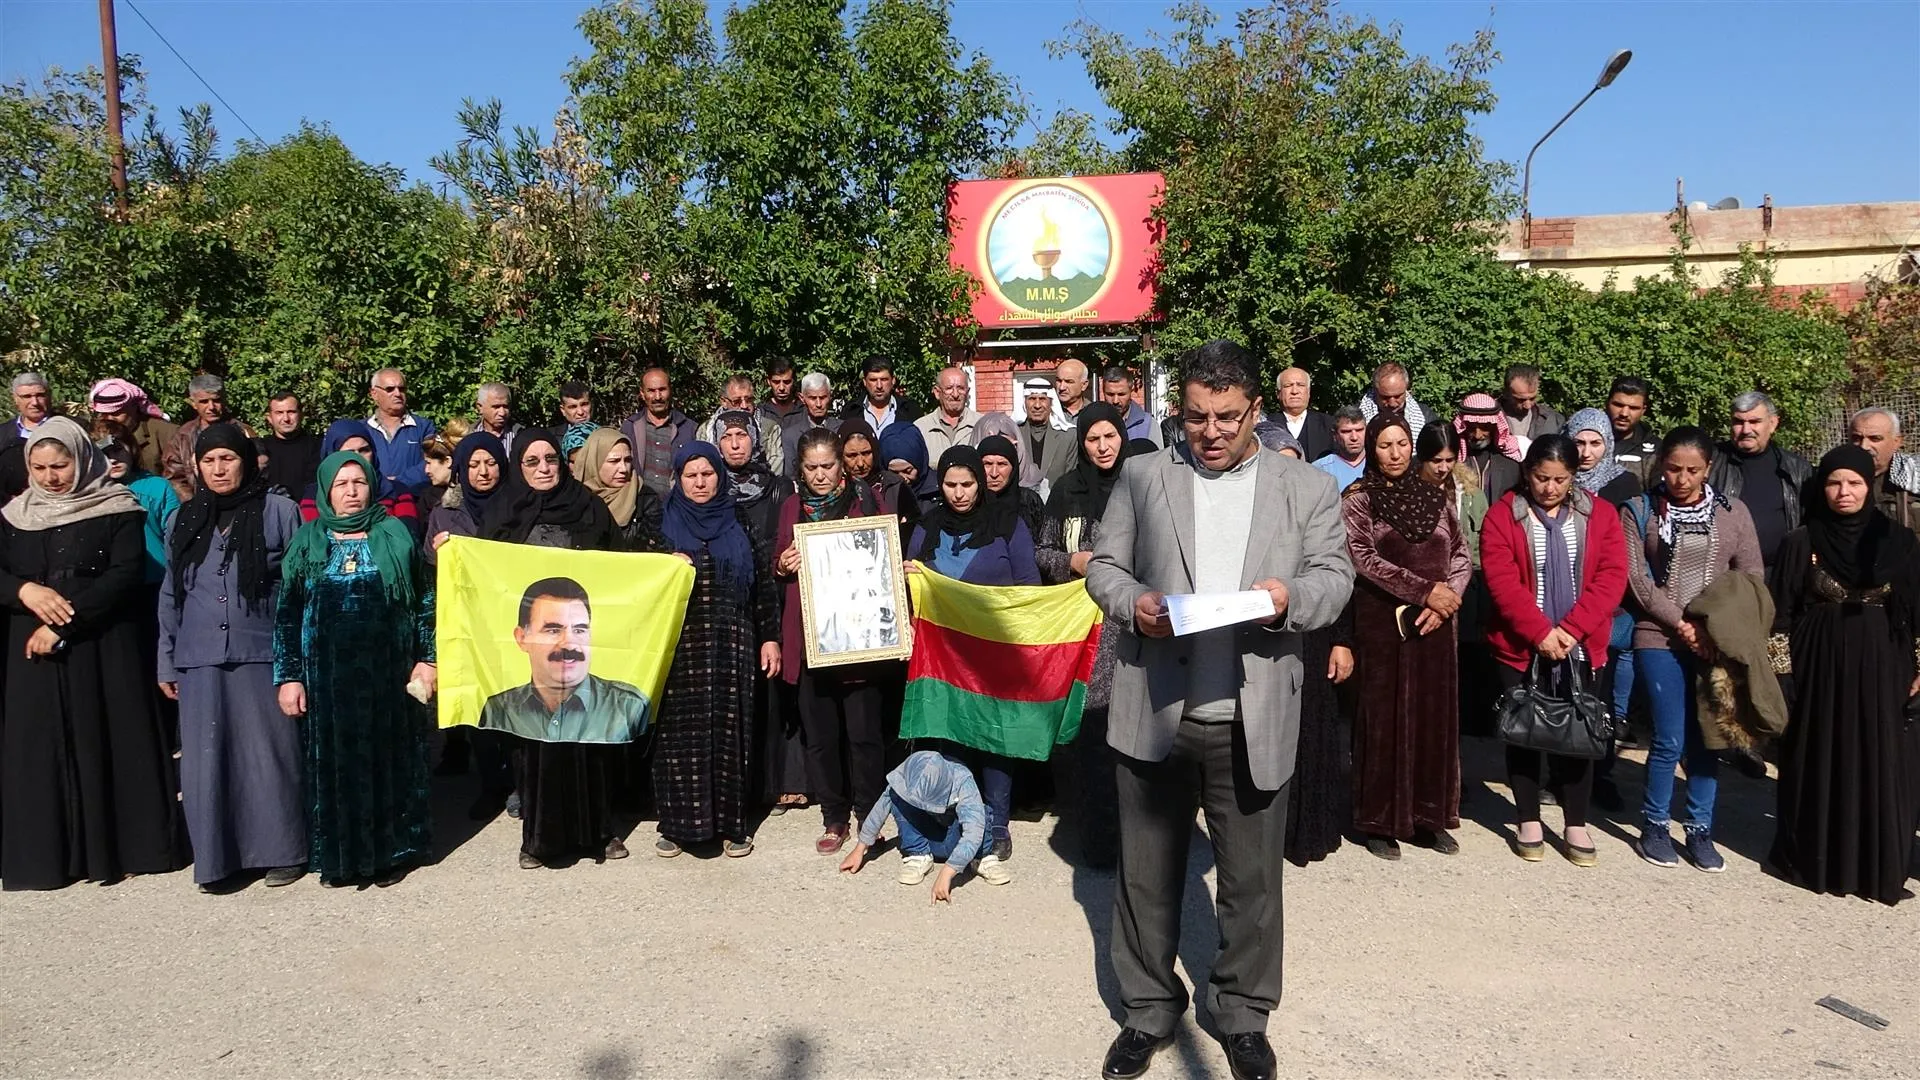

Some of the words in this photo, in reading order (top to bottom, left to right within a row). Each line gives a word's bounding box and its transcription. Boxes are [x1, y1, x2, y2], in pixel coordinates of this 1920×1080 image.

[1026, 286, 1069, 303] M.M.Ş
[999, 307, 1039, 321] الشهداء
[1069, 308, 1098, 322] مجلس
